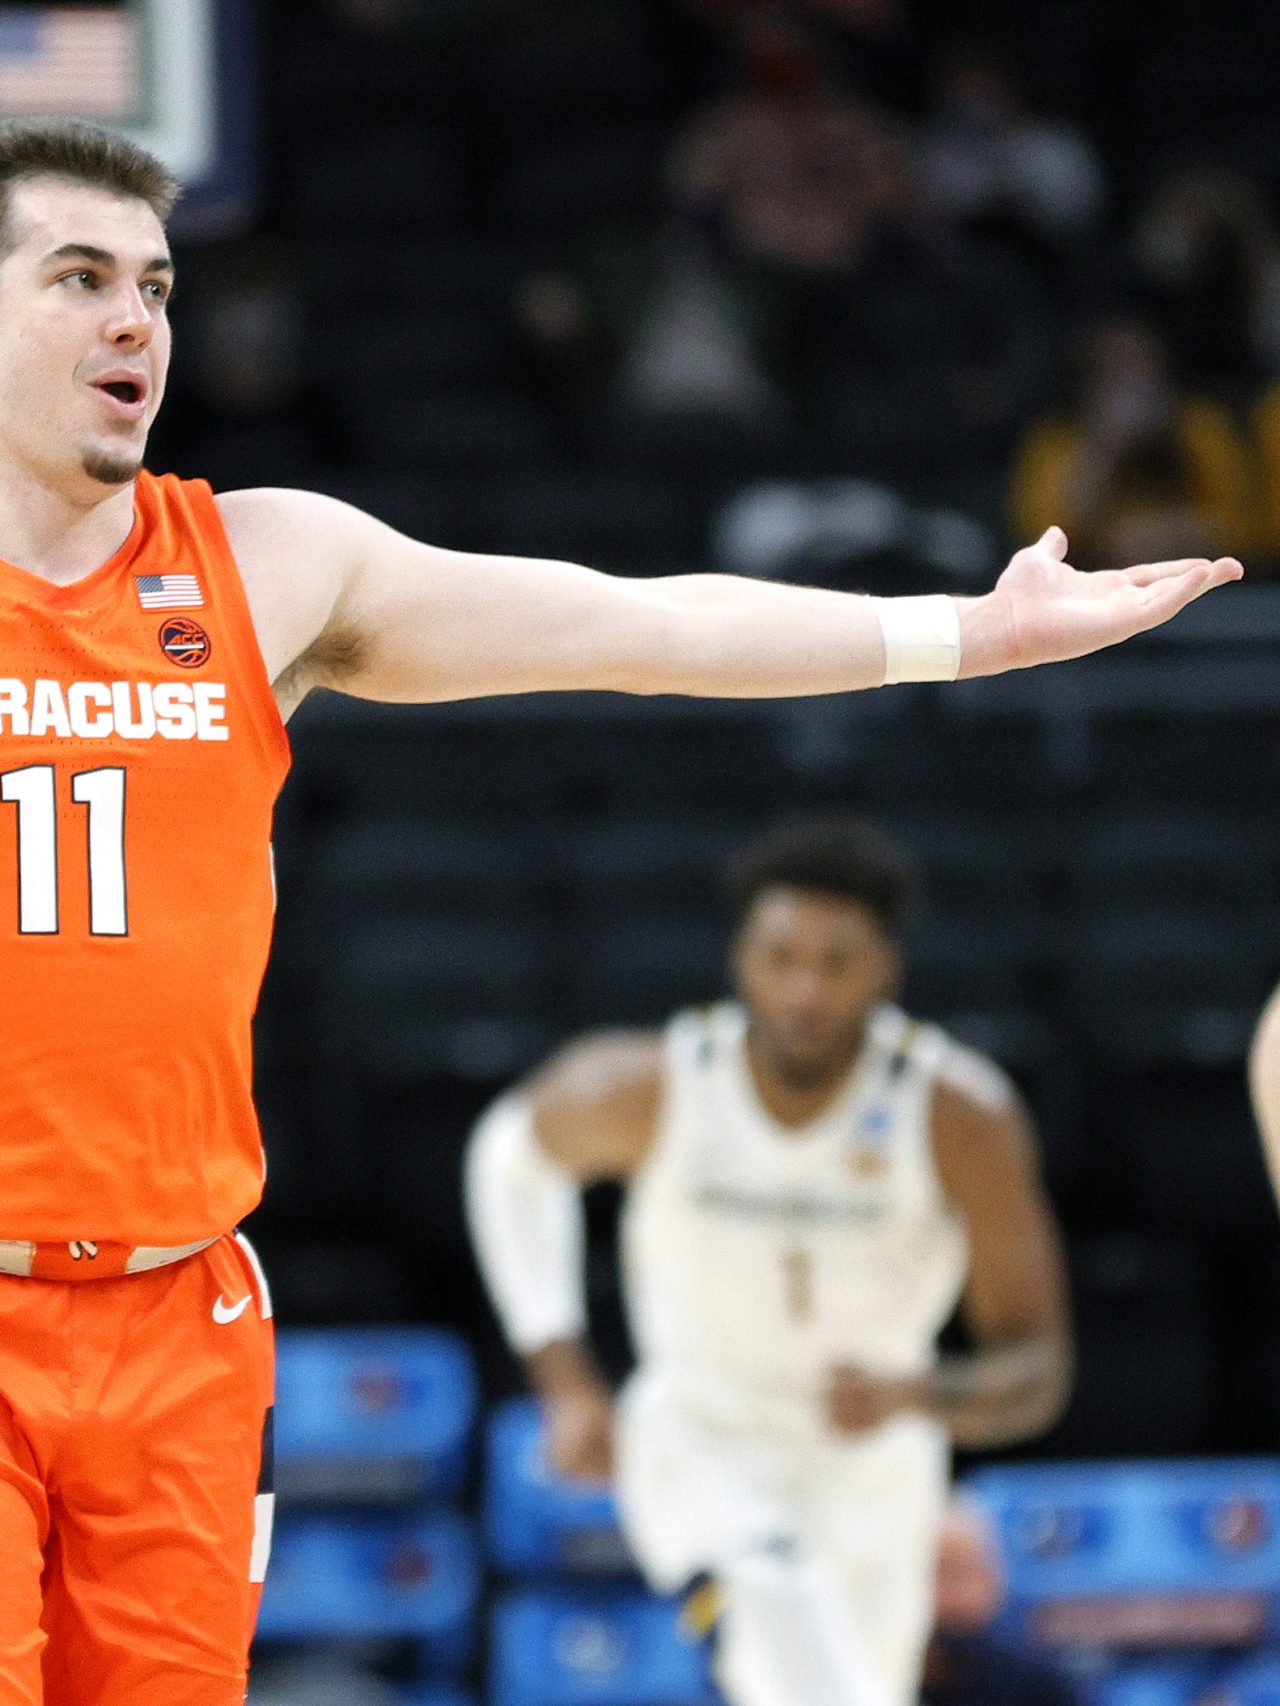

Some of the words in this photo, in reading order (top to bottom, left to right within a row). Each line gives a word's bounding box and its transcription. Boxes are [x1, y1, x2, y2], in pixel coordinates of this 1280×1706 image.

[169, 633, 205, 646] ACC
[0, 764, 129, 937] 11
[780, 1247, 814, 1324] 1
